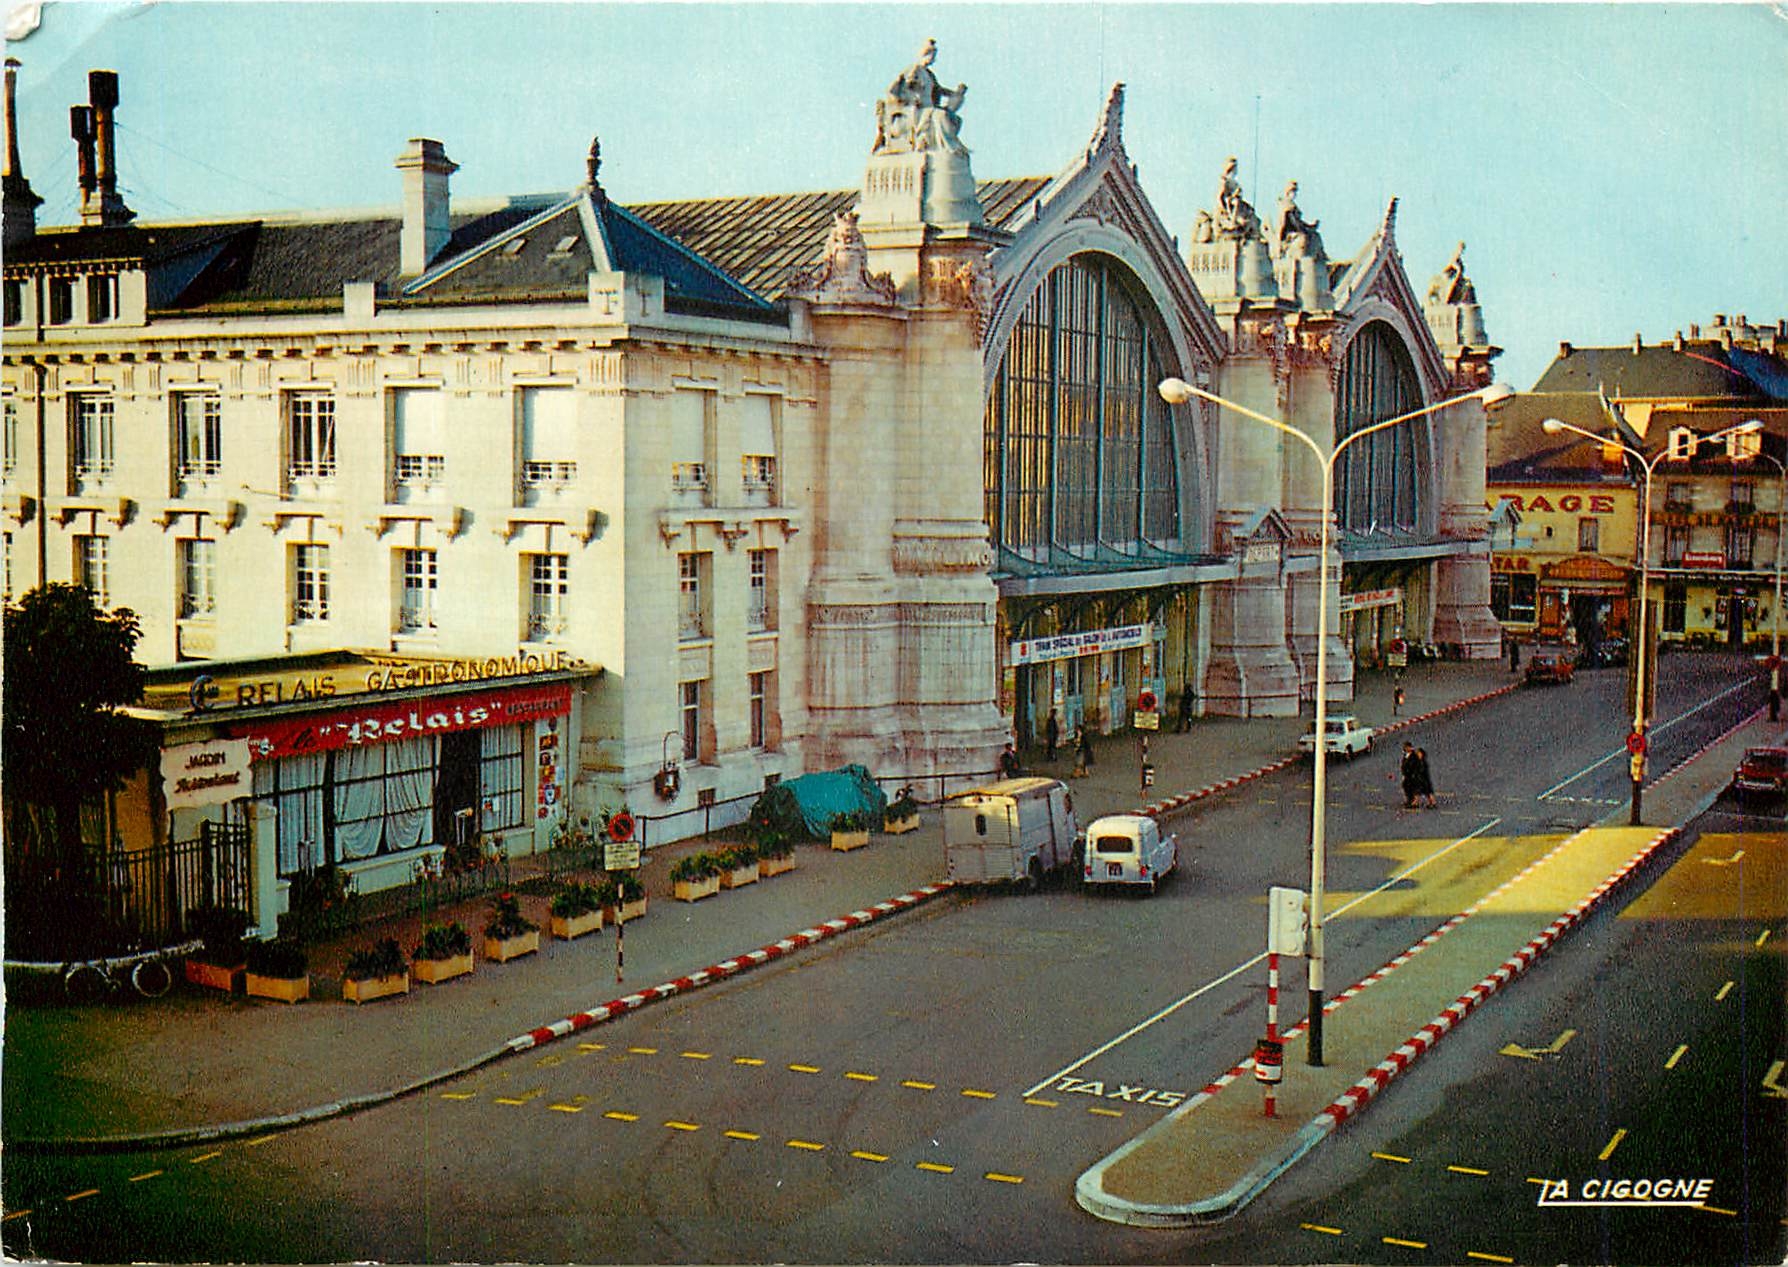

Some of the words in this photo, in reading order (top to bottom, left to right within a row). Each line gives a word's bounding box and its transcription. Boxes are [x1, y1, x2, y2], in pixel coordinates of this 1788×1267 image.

[1485, 494, 1615, 513] RAGE
[237, 676, 336, 706] RELAIS
[365, 650, 567, 690] GASTRONOMIQUE
[1056, 1076, 1186, 1108] TAXIS
